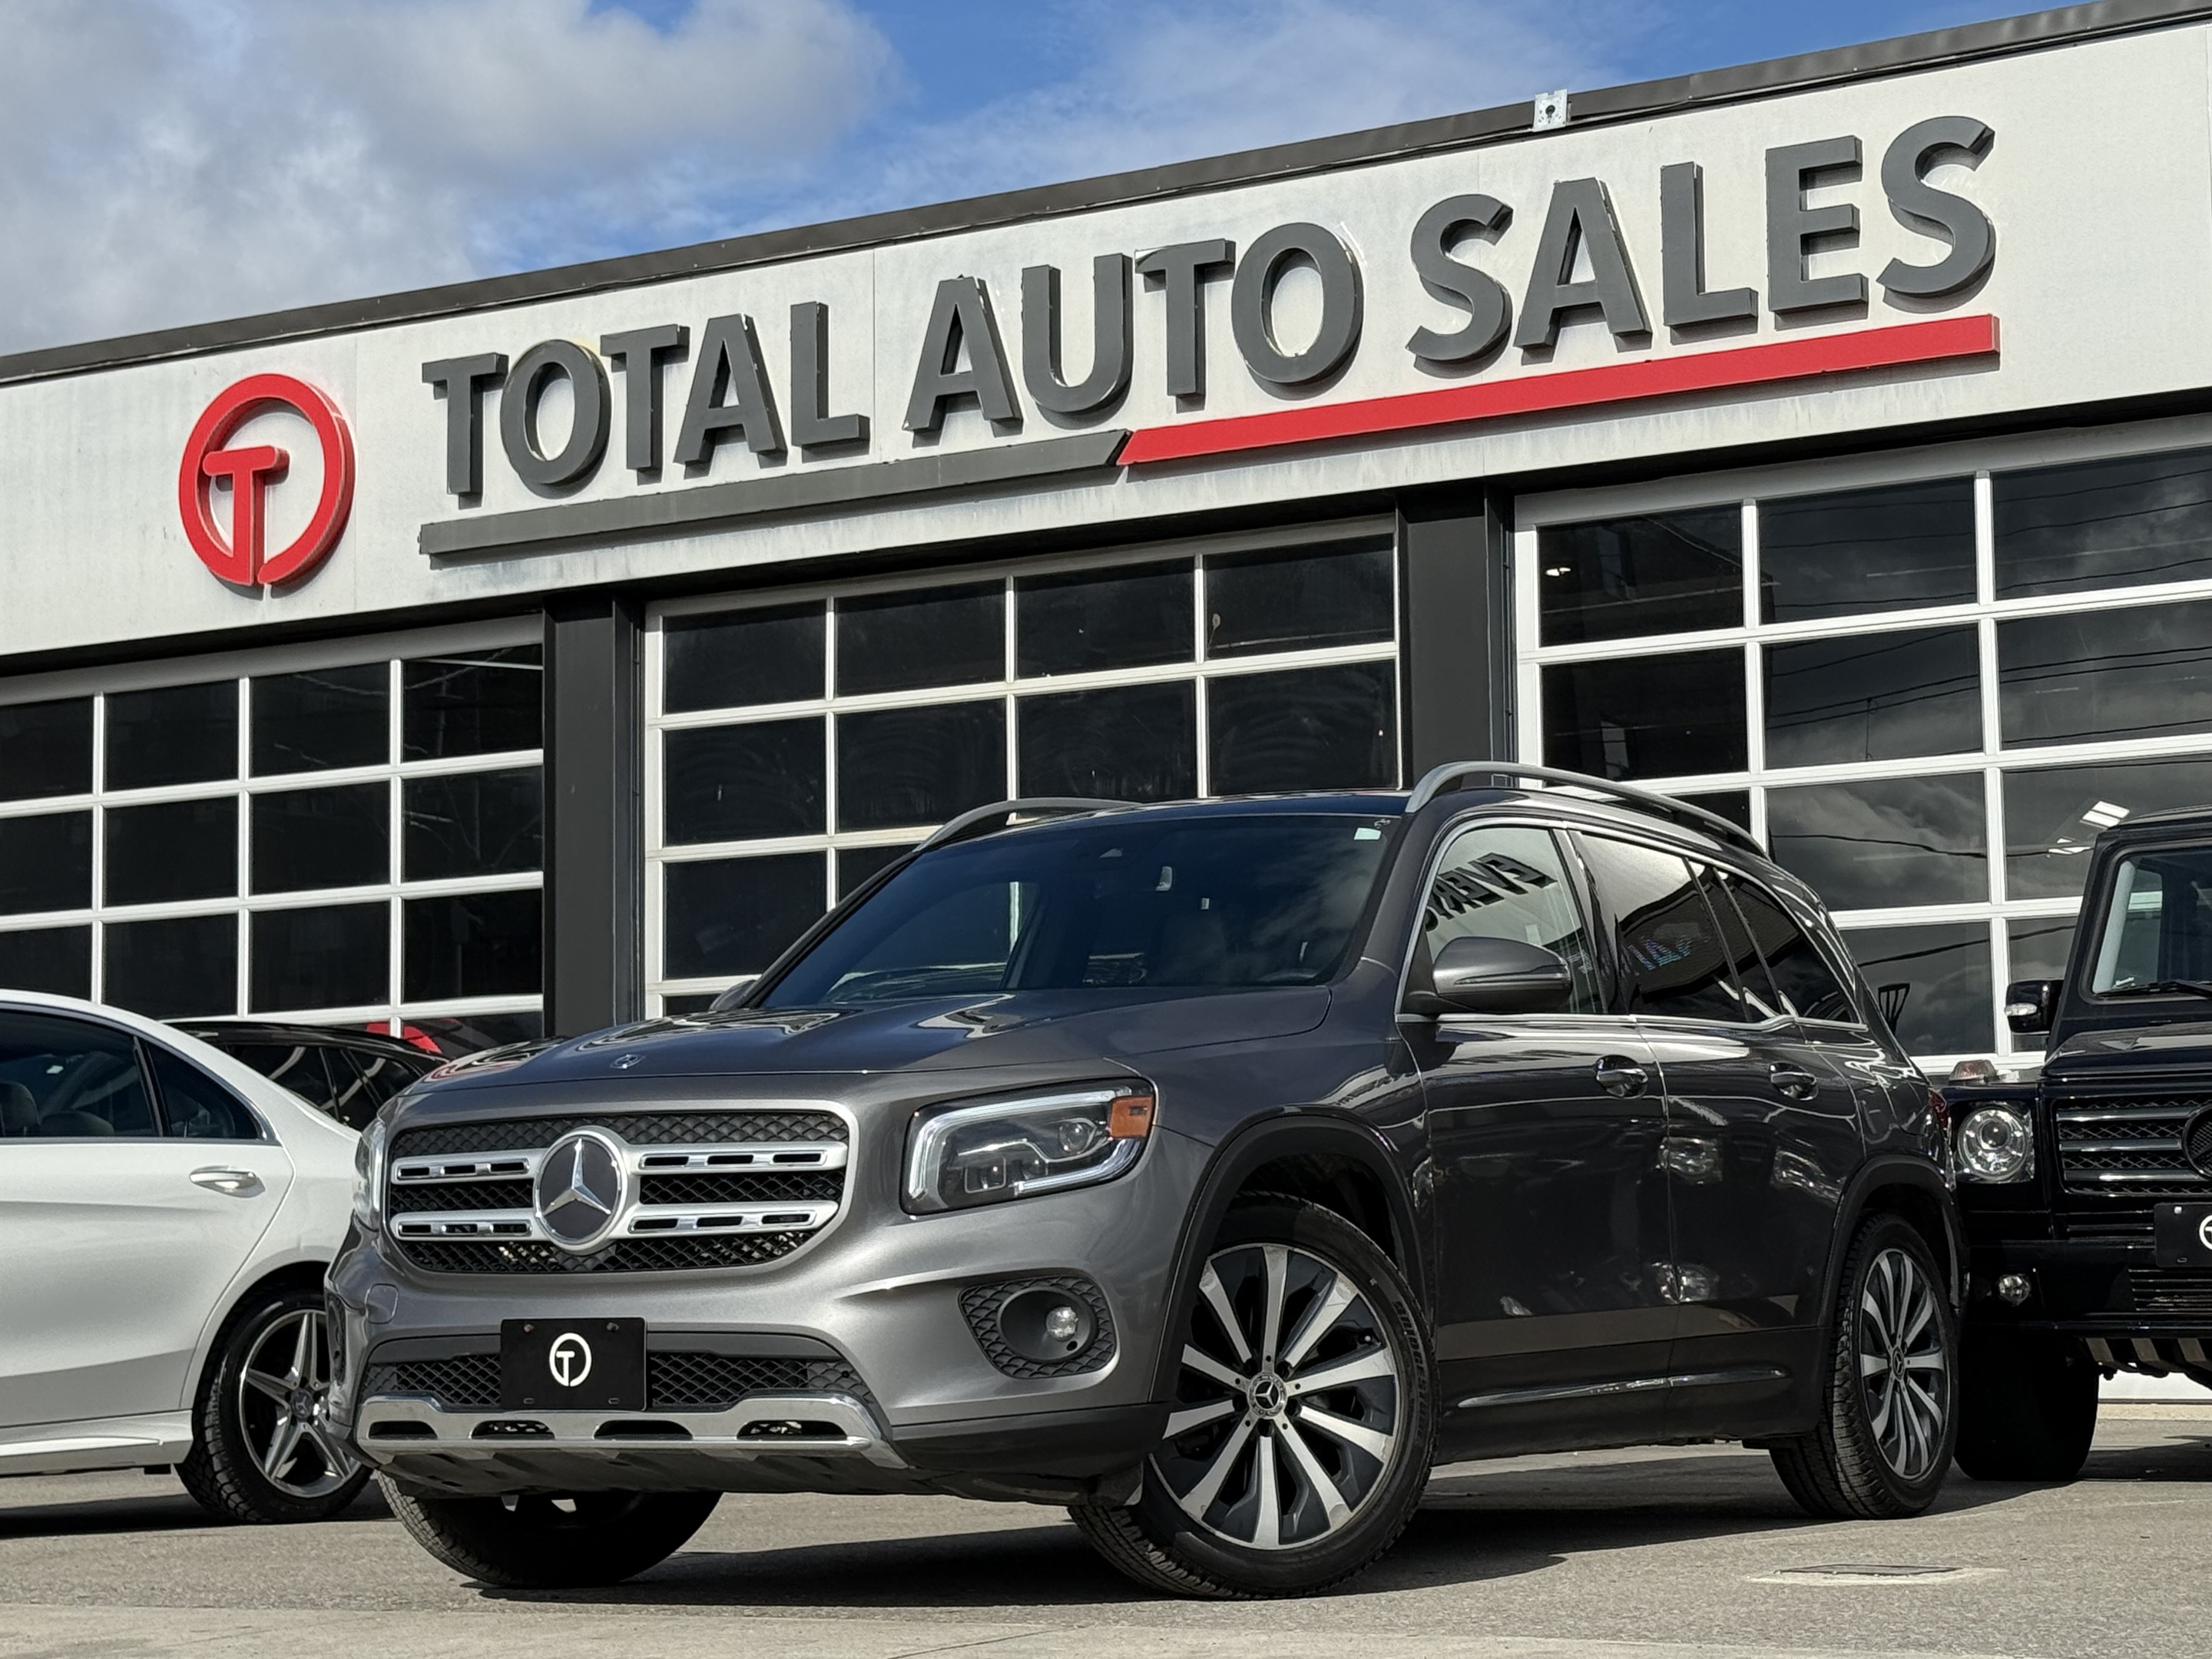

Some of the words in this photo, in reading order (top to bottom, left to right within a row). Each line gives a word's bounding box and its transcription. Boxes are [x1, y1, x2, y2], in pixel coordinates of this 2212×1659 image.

[422, 300, 869, 495] TOTAL
[902, 222, 1364, 432] AUTO
[1406, 115, 1996, 361] SALES
